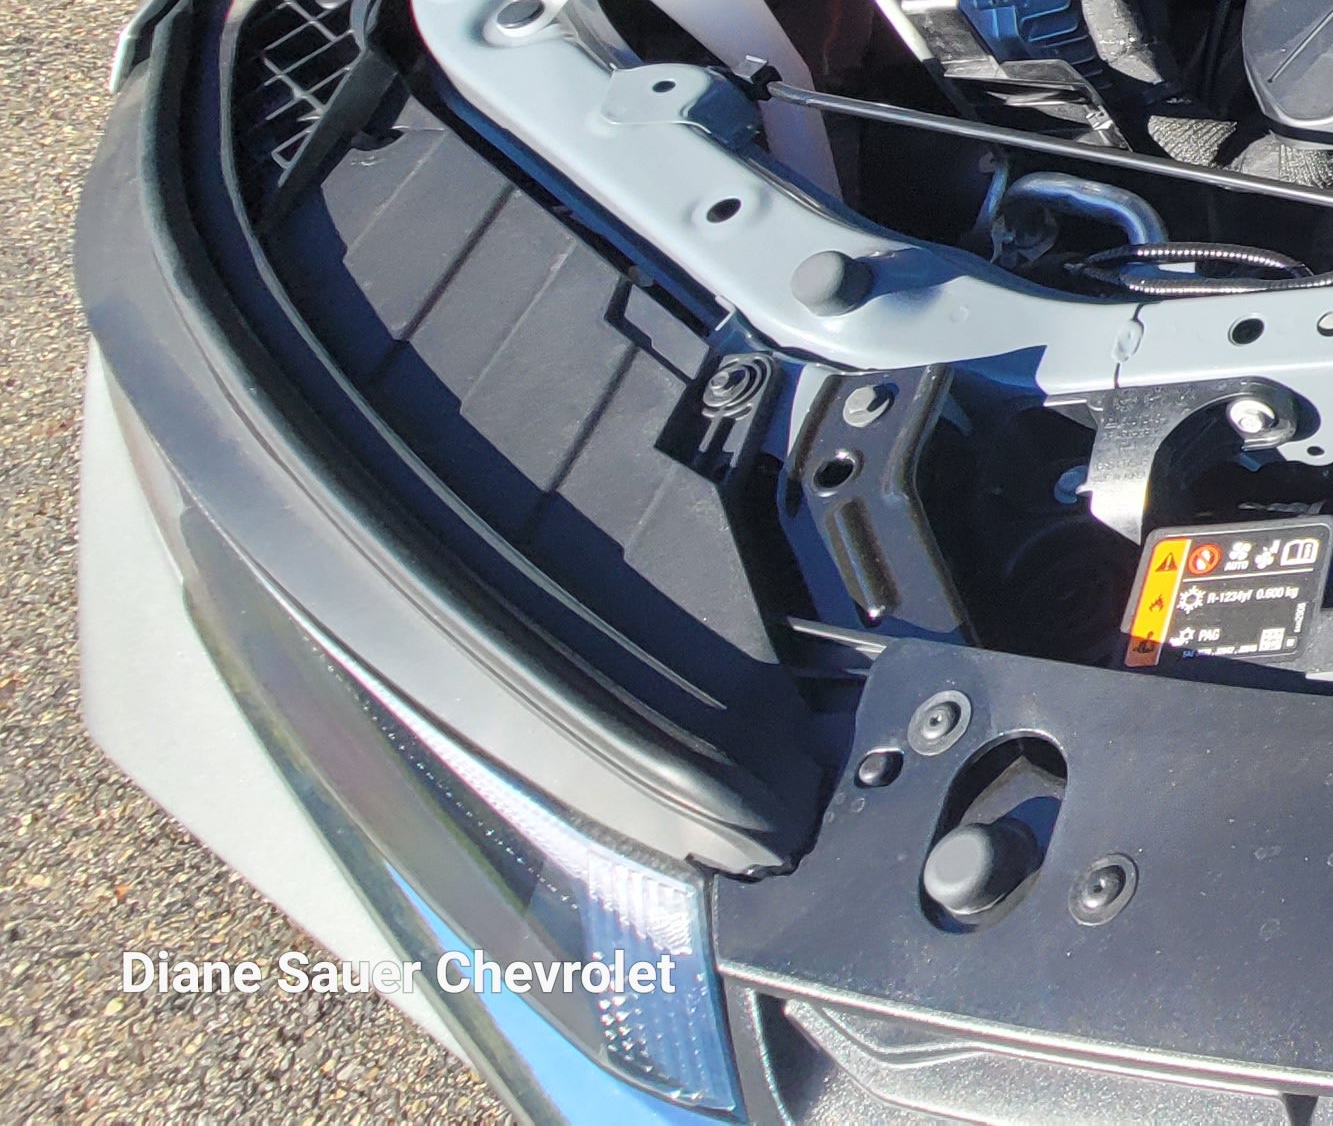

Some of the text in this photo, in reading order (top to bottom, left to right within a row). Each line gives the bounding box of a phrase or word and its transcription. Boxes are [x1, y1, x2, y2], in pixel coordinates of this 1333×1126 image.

[1224, 561, 1249, 572] AUTO
[1206, 589, 1254, 604] R-1234yf
[1285, 586, 1300, 599] kg
[1198, 628, 1221, 642] PAG
